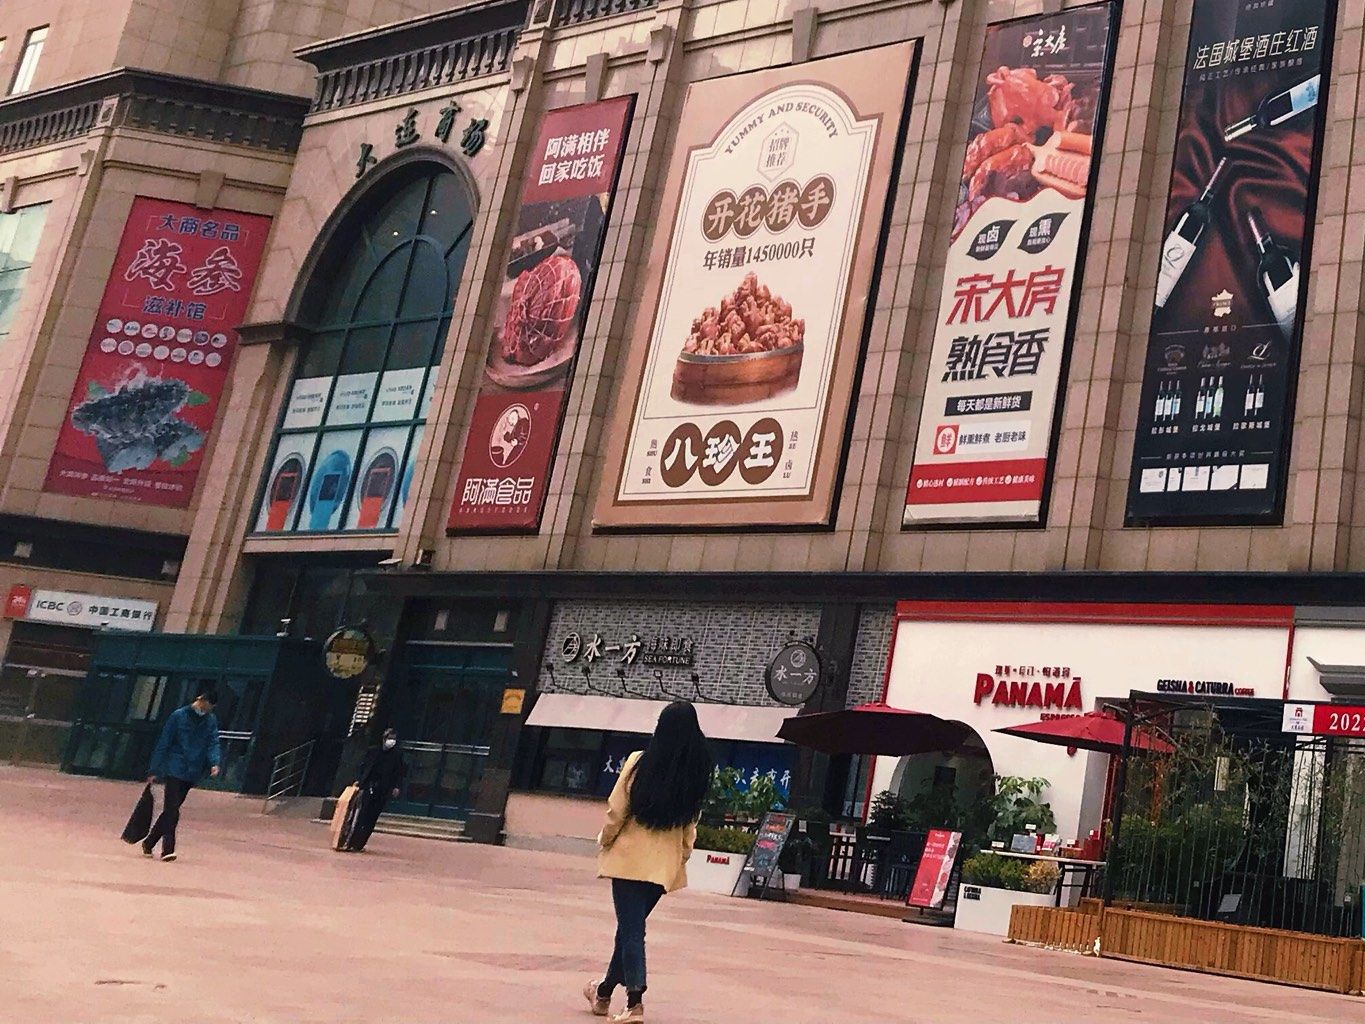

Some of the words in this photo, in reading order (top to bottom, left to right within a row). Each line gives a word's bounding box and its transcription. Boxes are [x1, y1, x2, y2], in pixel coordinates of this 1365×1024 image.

[1193, 26, 1320, 70] 法国城堡酒庄红酒
[355, 100, 490, 178] 大连商场
[544, 127, 610, 160] 阿满相伴
[724, 113, 766, 154] YUMMY
[768, 102, 794, 119] AND
[795, 102, 839, 139] SECURITY
[769, 137, 790, 152] 招牌
[538, 154, 605, 187] 回家吃饭
[766, 152, 786, 168] 推荐
[706, 181, 830, 234] 开花猪手
[160, 214, 241, 241] 大商名品
[125, 238, 243, 295] 海参
[702, 237, 816, 270] 年销量1450000只
[142, 295, 207, 321] 滋补馆
[945, 265, 1066, 325] 宋大房
[941, 327, 1051, 383] 熟食香
[956, 394, 1022, 413] 每天都是新鲜货
[664, 432, 776, 474] 八珍王
[36, 600, 64, 611] ICBC
[88, 604, 153, 621] 中国工商银行
[584, 633, 641, 665] 水一方
[644, 655, 657, 664] SEA
[658, 656, 690, 665] FORTUNE
[773, 665, 817, 685] 水一方
